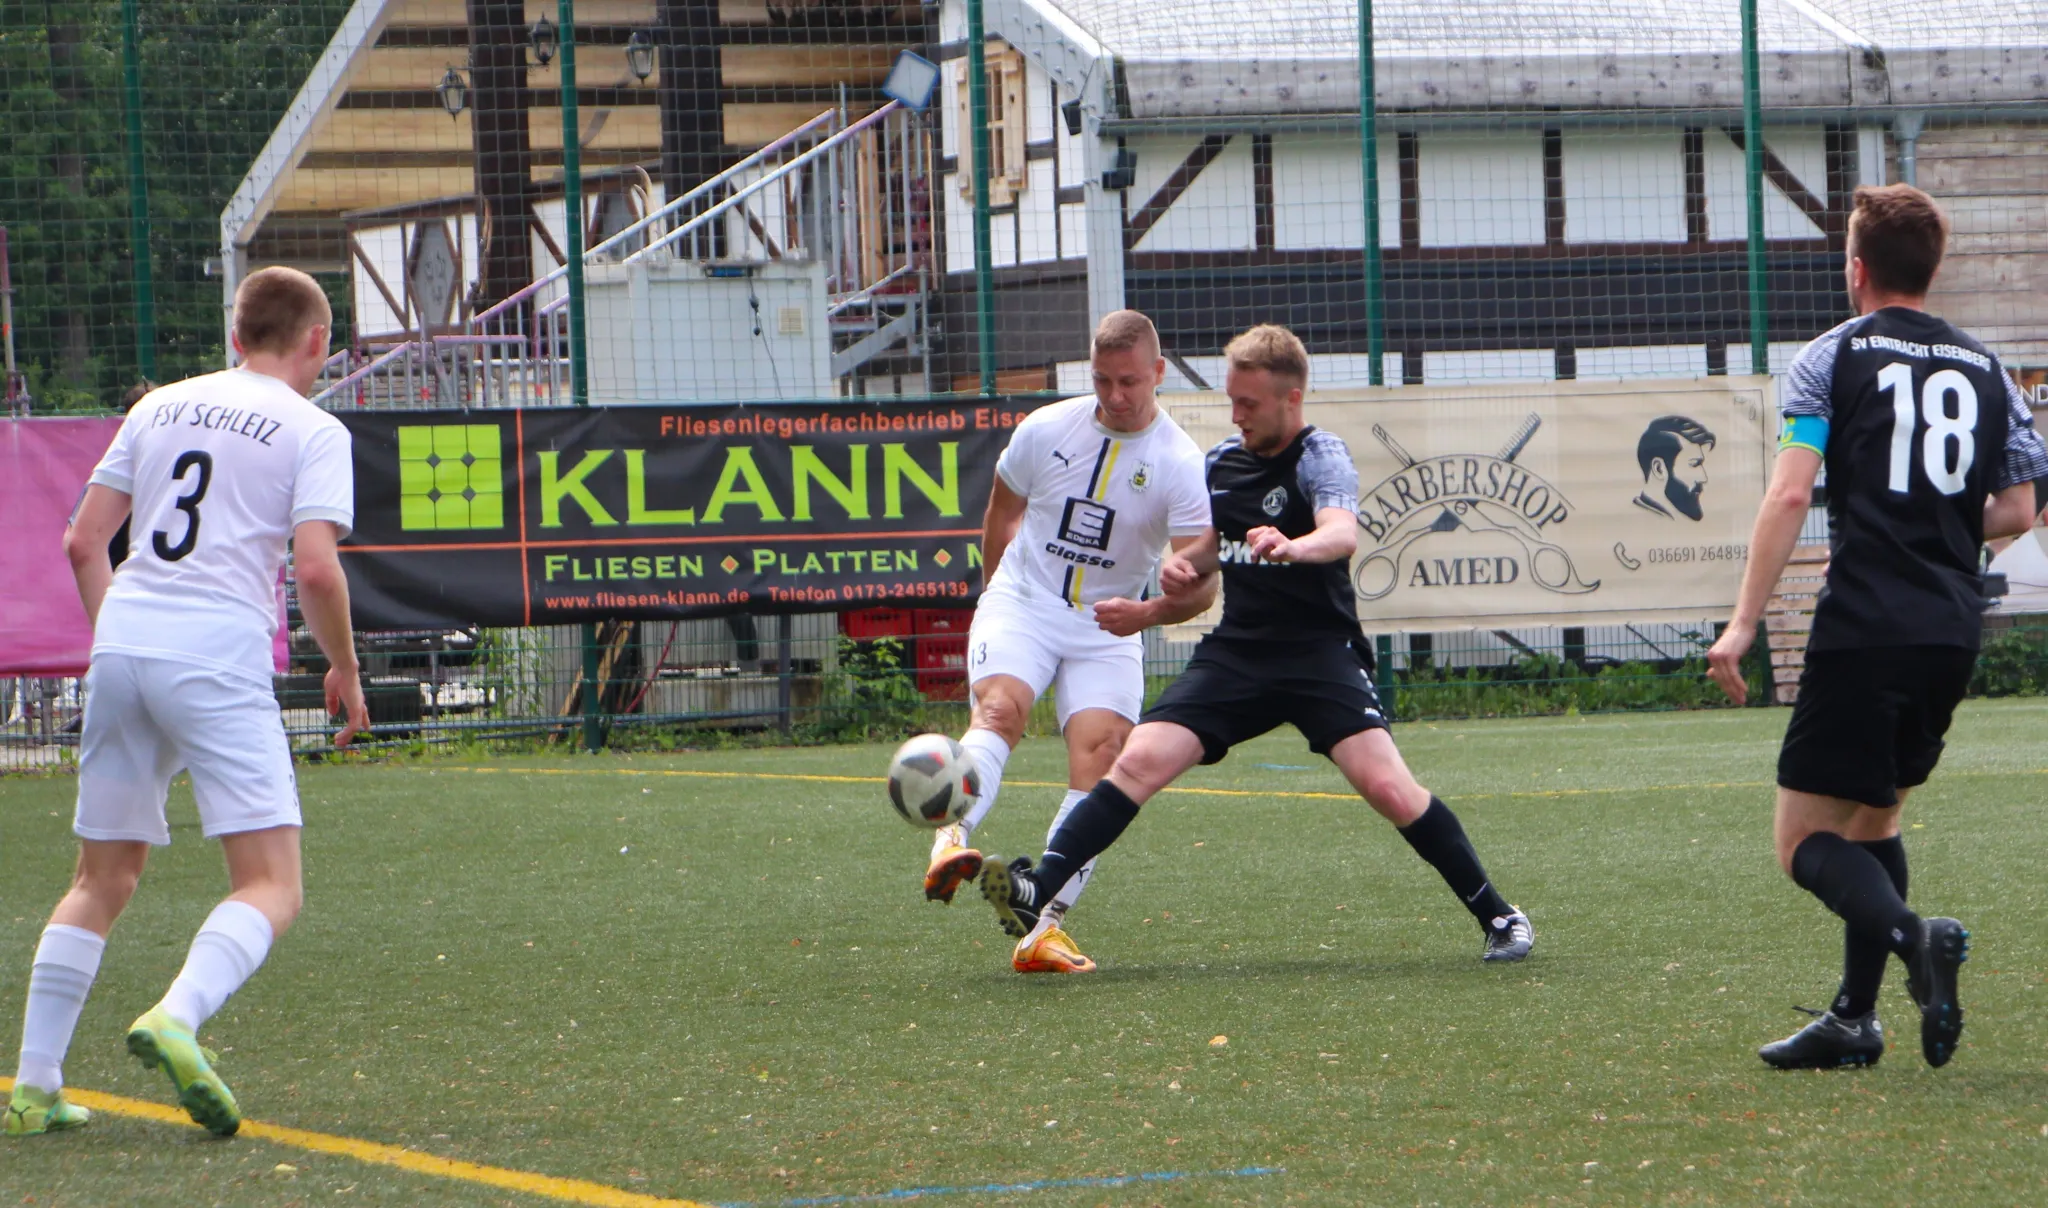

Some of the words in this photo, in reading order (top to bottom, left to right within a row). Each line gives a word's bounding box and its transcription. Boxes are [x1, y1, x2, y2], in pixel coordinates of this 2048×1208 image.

[1851, 336, 1868, 351] SV
[1869, 335, 1930, 358] EINTRACHT
[1932, 343, 1992, 373] EISENBERG
[151, 401, 189, 429] FSV
[190, 403, 283, 447] SCHLEIZ
[661, 408, 966, 438] Fliesenlegerfachbetrieb
[1877, 361, 1979, 496] 18
[537, 441, 963, 528] KLANN
[152, 449, 213, 562] 3
[1357, 458, 1570, 543] BARBERSHOP
[1065, 531, 1100, 546] EDEKA
[1648, 546, 1695, 564] 036691
[1409, 556, 1520, 587] AMED
[545, 589, 750, 609] www.fliesen-klann.de
[769, 585, 837, 603] Telefon
[843, 581, 969, 600] 0173-2455139
[971, 641, 988, 671] 13
